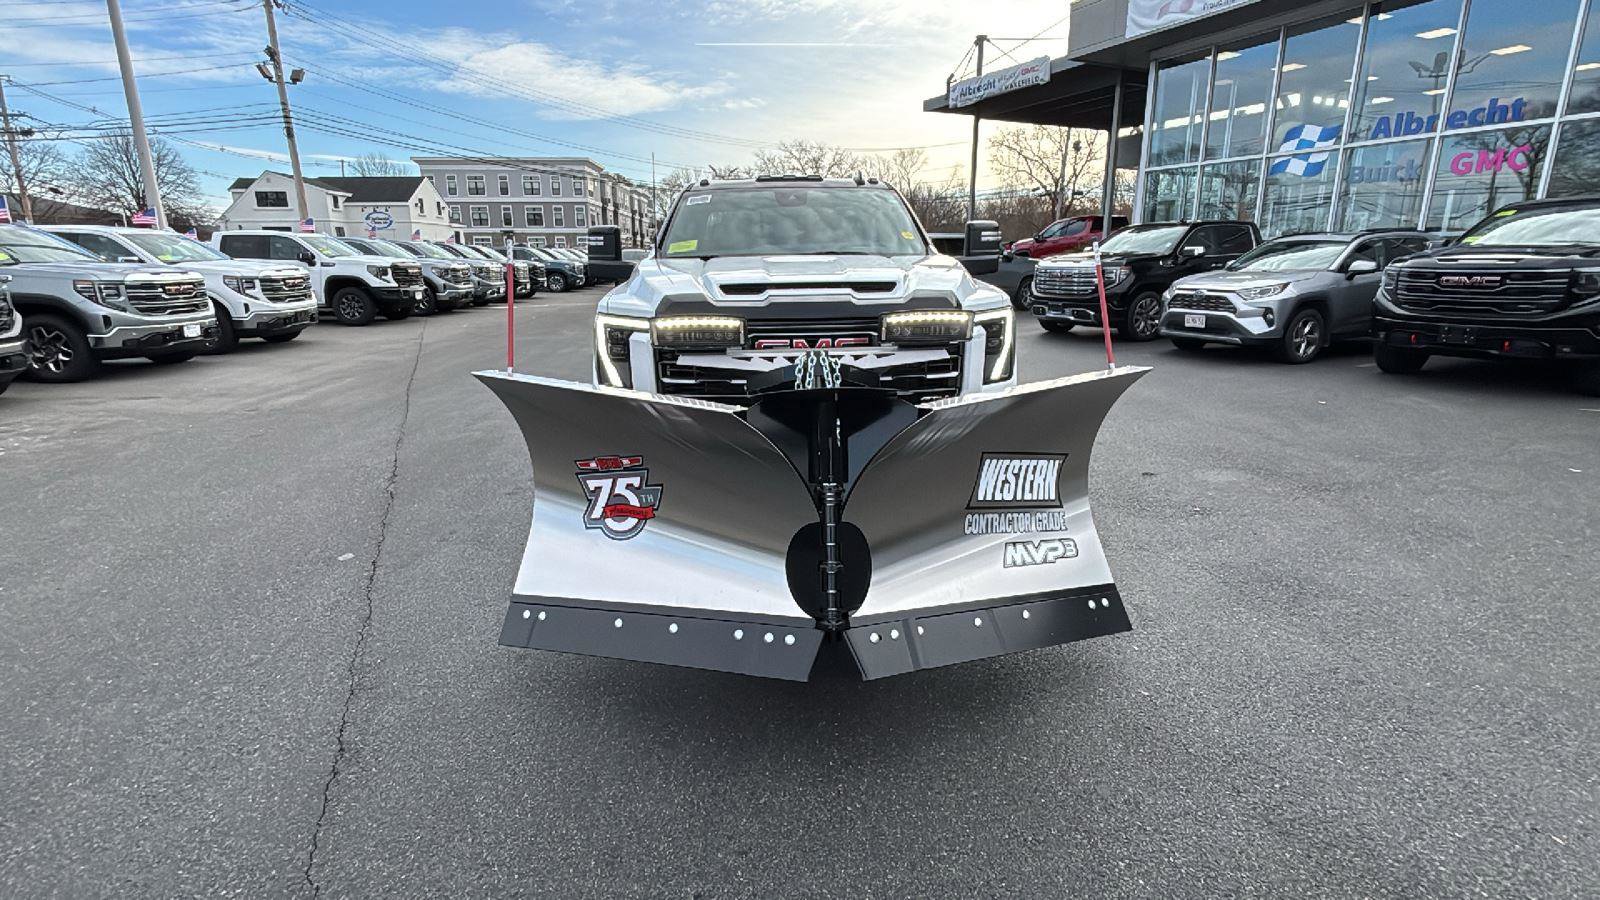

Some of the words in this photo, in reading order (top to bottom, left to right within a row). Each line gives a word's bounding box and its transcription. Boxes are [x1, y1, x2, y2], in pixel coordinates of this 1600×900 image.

[1371, 97, 1527, 140] Albrecht
[1350, 159, 1422, 184] Buick
[1451, 144, 1533, 175] GMC
[1440, 276, 1501, 286] GMC
[640, 494, 654, 503] TH
[977, 459, 1060, 501] WESTERN
[586, 476, 641, 531] 75
[964, 512, 1034, 535] CONTRACTOR
[1035, 511, 1068, 533] GRADE
